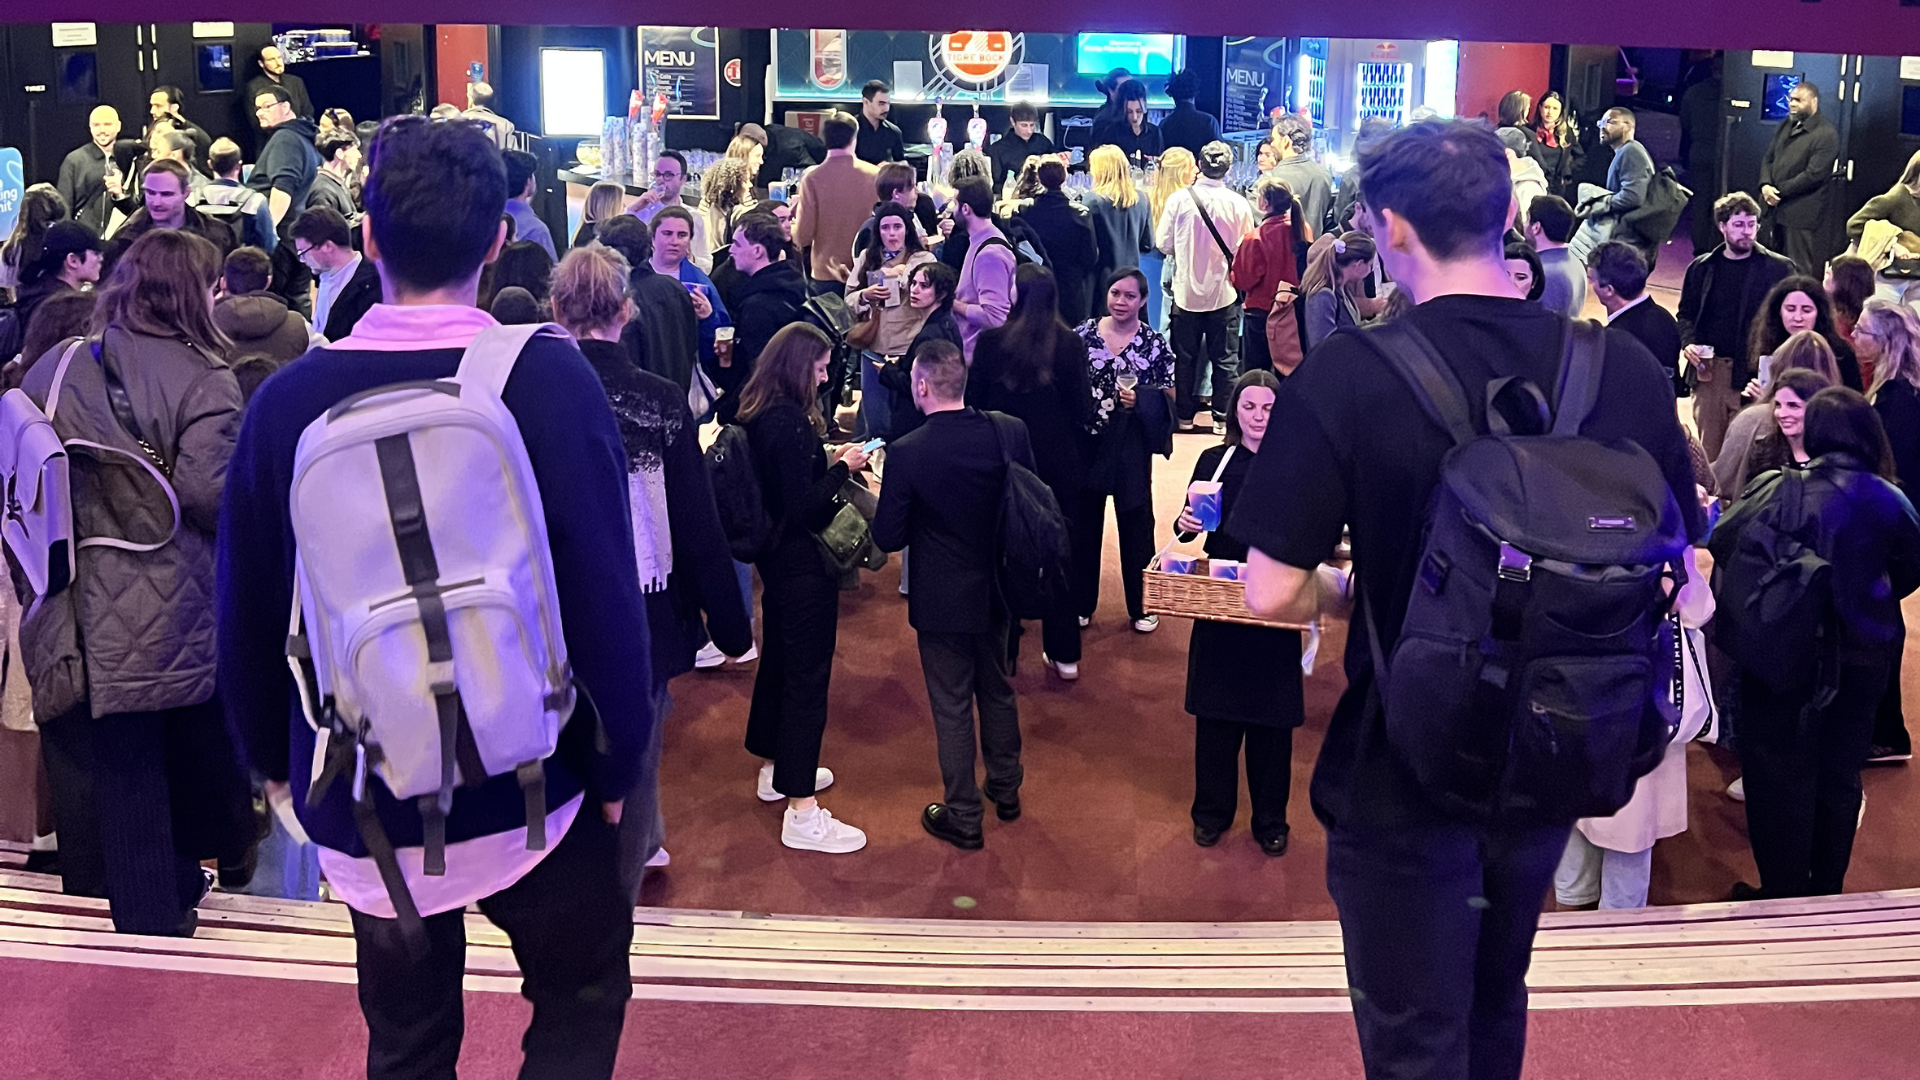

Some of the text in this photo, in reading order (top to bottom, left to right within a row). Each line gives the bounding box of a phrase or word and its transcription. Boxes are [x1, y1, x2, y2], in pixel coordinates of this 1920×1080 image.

[644, 51, 695, 67] MENU
[947, 53, 1004, 62] TIGRE BOCK
[1226, 67, 1265, 87] MENU
[1672, 634, 1682, 670] JIMMY
